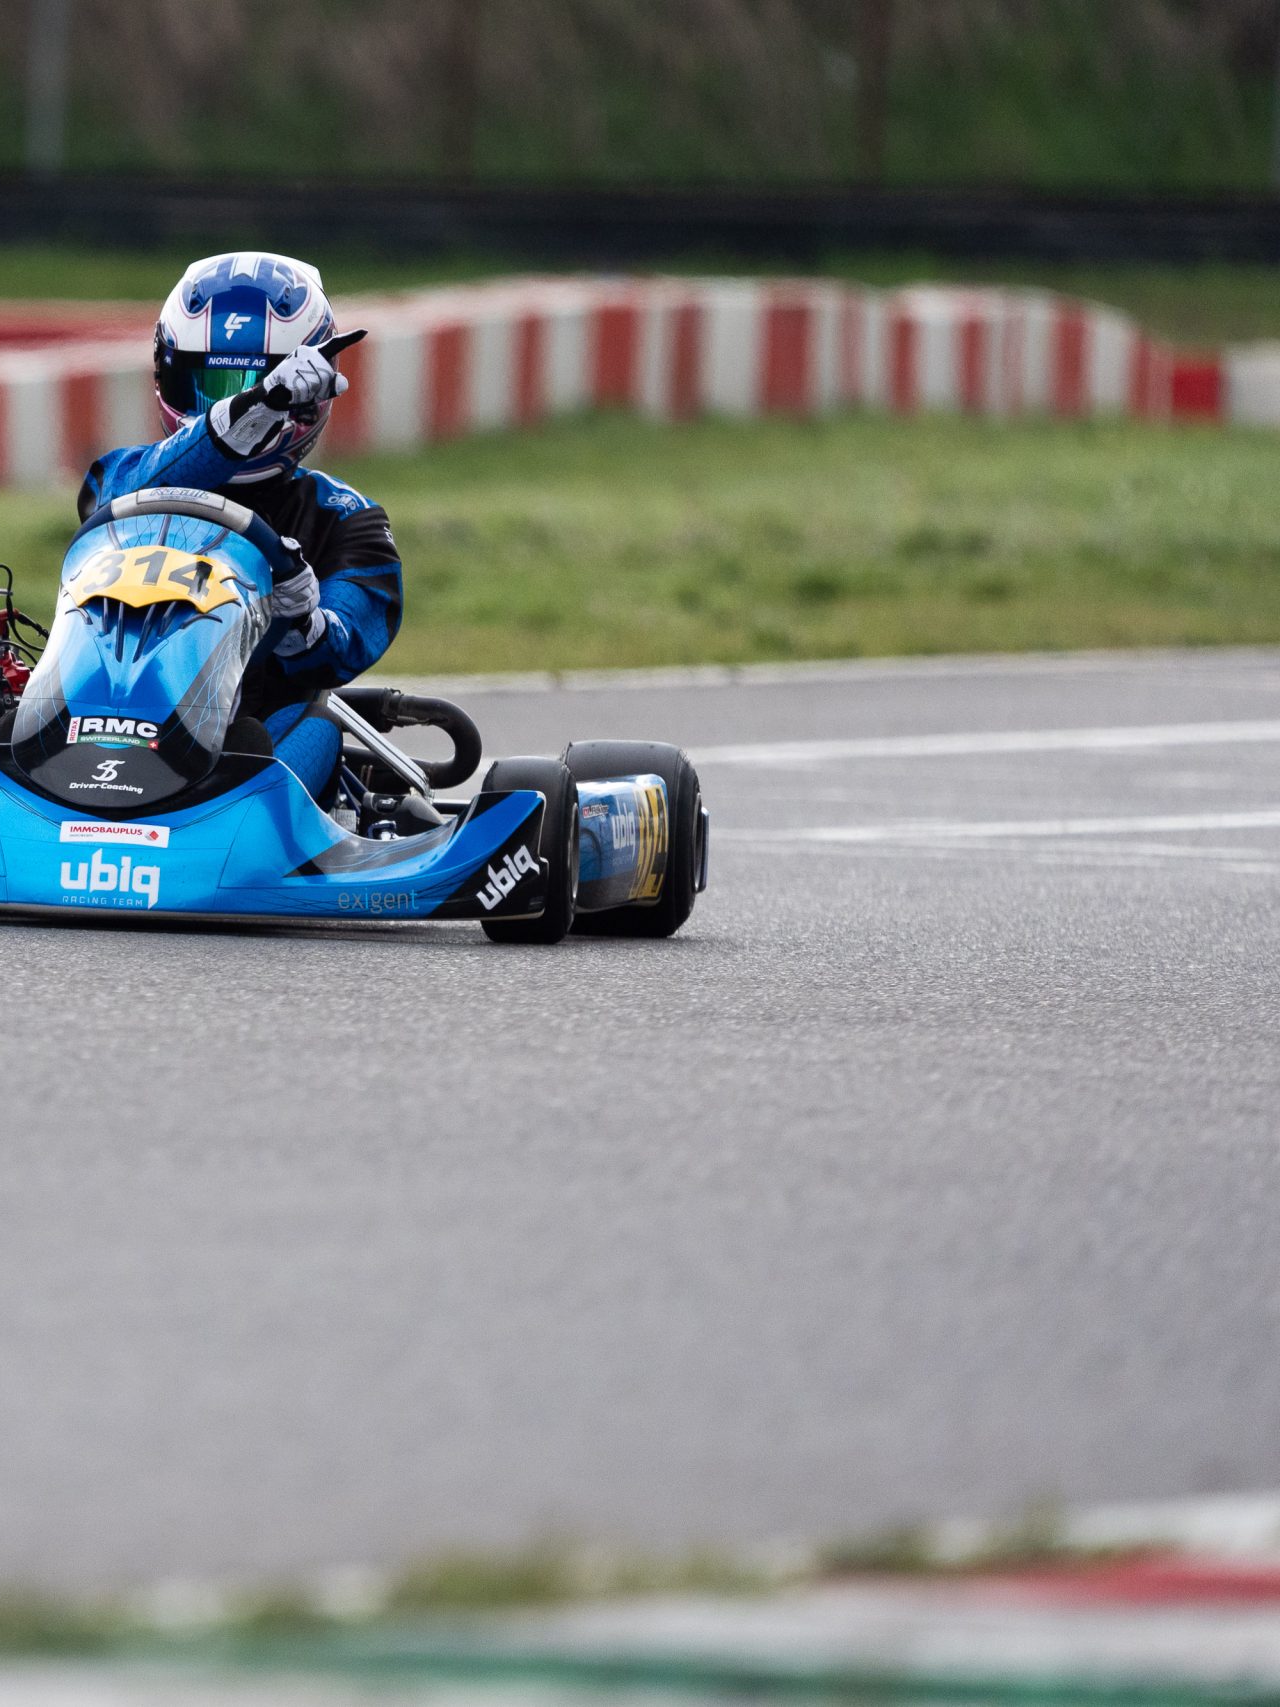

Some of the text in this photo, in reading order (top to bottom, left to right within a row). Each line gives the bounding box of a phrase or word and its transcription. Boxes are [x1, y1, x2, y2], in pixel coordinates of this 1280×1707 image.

[208, 357, 267, 367] NORLINE AG
[327, 495, 357, 511] OMP
[83, 550, 211, 601] 314
[69, 720, 79, 741] ROTAX
[82, 718, 158, 738] RMC
[80, 736, 141, 745] SWITZERLAND
[69, 782, 144, 795] Driver-Coaching
[70, 825, 143, 836] IMMOBAUPLUS
[62, 896, 143, 906] RACING TEAM
[337, 888, 420, 914] exigent
